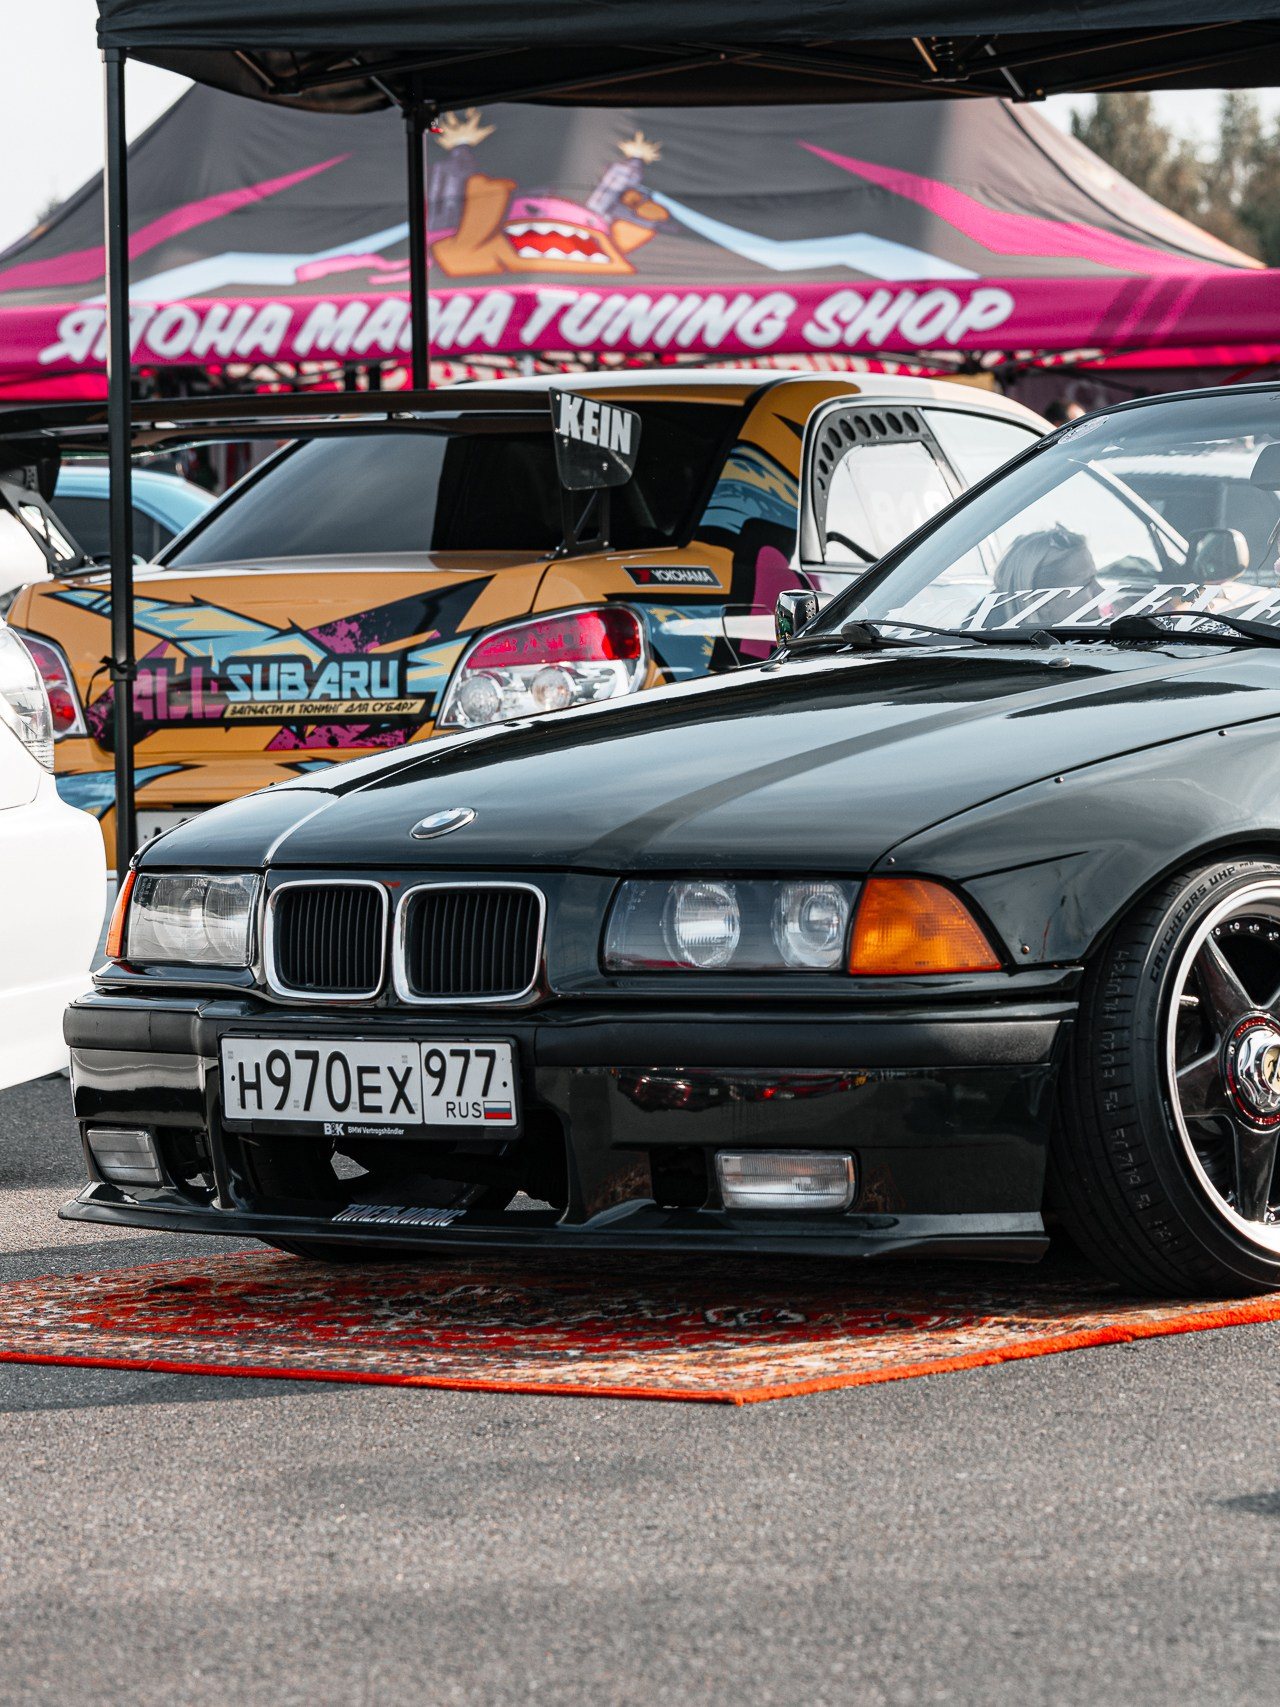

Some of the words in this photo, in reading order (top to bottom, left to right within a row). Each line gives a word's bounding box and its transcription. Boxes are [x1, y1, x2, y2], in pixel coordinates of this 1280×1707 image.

[519, 289, 796, 347] TUNING
[803, 287, 1014, 347] SHOP
[560, 392, 632, 455] KEIN
[651, 568, 714, 583] YOKOHAMA
[226, 659, 399, 701] SUBARU
[230, 703, 284, 716] ЗАПЧАСТИ
[286, 703, 296, 714] И
[299, 702, 343, 714] ТЮНИНГ
[344, 702, 369, 713] ДЛЯ
[372, 701, 417, 713] СУБАРУ
[1150, 883, 1207, 983] CATCHFORS
[1208, 864, 1236, 887] UHP
[424, 1048, 496, 1097] 977
[323, 1122, 345, 1136] B&K
[347, 1126, 362, 1134] BMW
[446, 1101, 482, 1118] RUS
